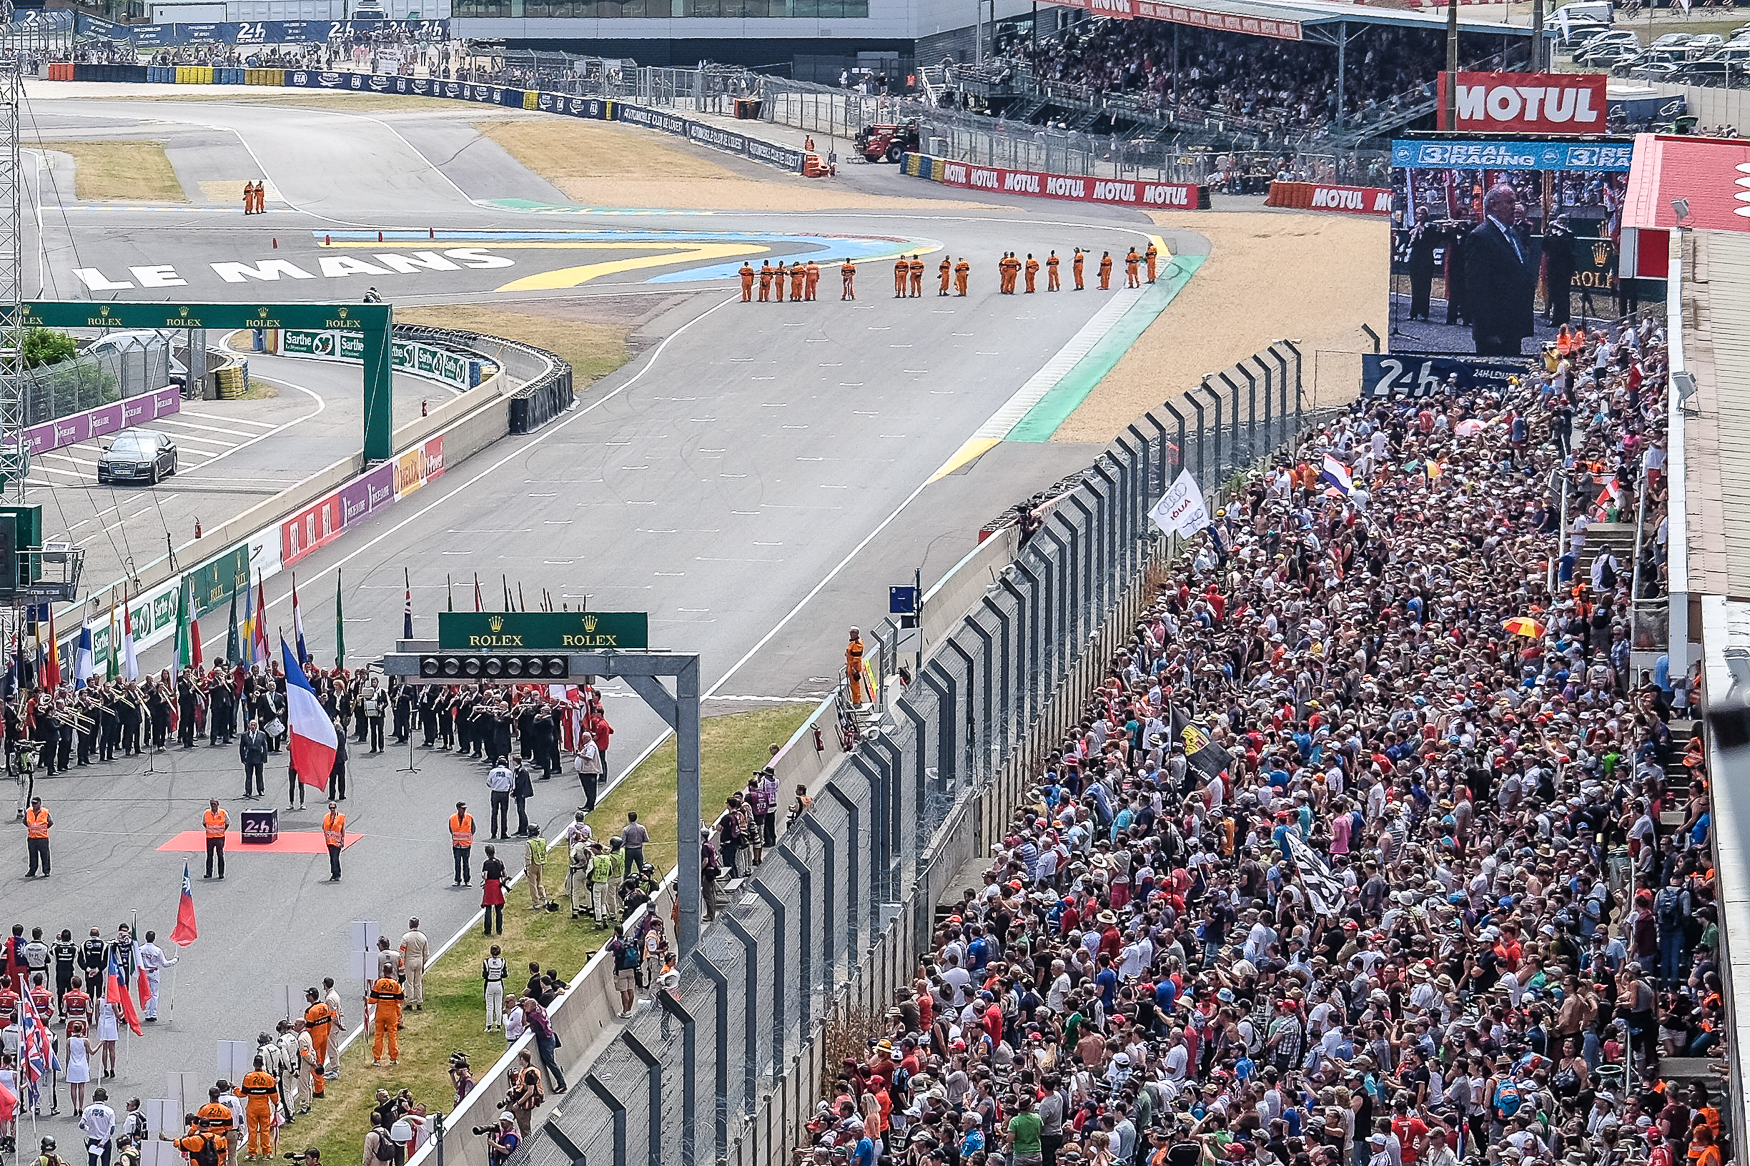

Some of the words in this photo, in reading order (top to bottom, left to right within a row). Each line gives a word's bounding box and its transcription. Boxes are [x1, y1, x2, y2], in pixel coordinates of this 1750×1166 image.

[237, 22, 266, 39] 24h
[1455, 86, 1598, 122] MOTUL
[1451, 145, 1511, 156] REAL
[1450, 155, 1535, 167] RACING
[944, 163, 966, 183] MOTUL
[971, 169, 998, 188] MOTUL
[1004, 173, 1040, 193] MOTUL
[1046, 176, 1085, 198] MOTUL
[1093, 181, 1136, 202] MOTUL
[1143, 184, 1188, 205] MOTUL
[1311, 189, 1364, 210] MOTUL
[72, 264, 189, 291] LE
[209, 248, 516, 283] MANS
[87, 317, 122, 326] ROLEX
[166, 318, 202, 327] ROLEX
[246, 319, 281, 328] ROLEX
[326, 319, 361, 328] ROLEX
[286, 332, 311, 345] Sarthe
[470, 635, 523, 646] ROLEX
[563, 635, 617, 646] ROLEX
